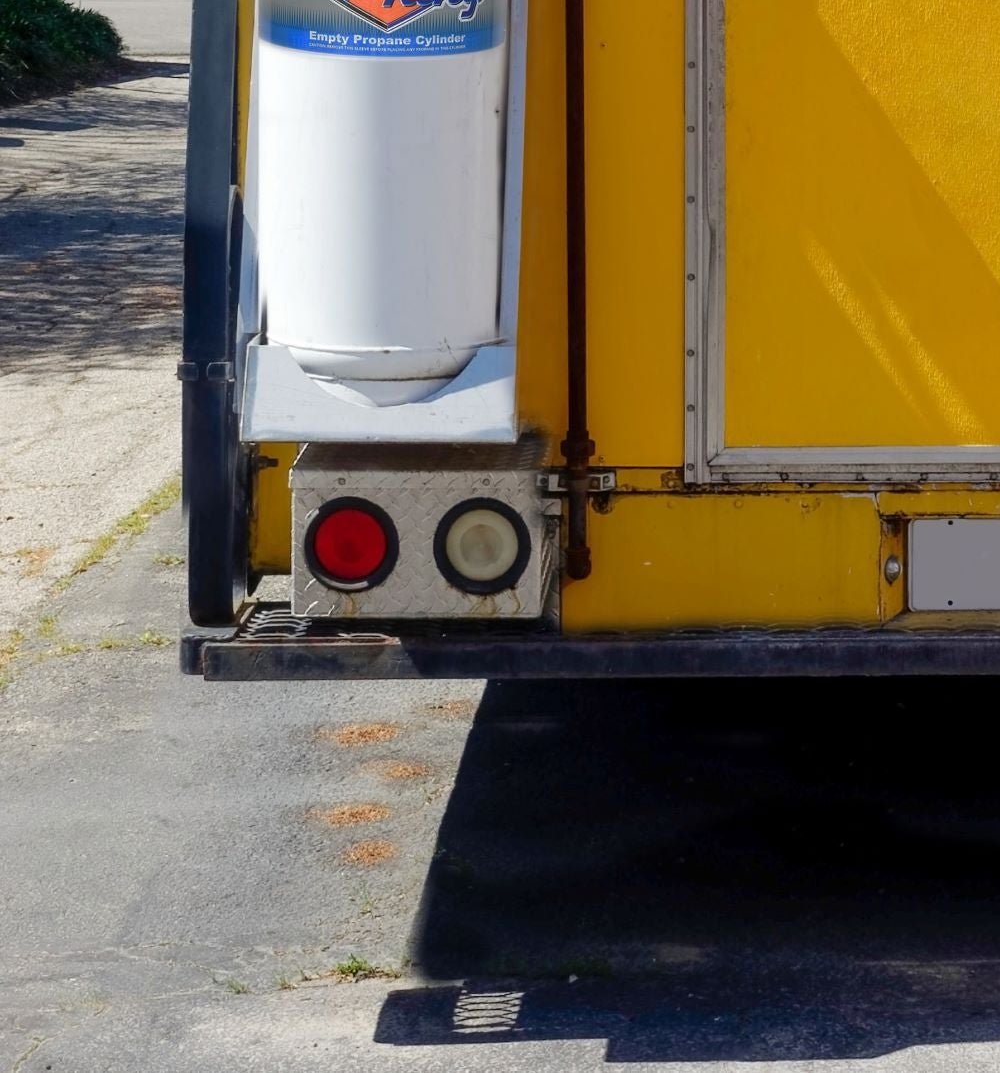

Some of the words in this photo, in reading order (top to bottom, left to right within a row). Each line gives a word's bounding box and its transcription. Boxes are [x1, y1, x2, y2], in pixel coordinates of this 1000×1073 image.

[309, 30, 349, 45] Empty
[353, 34, 411, 47] Propane
[415, 34, 466, 47] Cylinder
